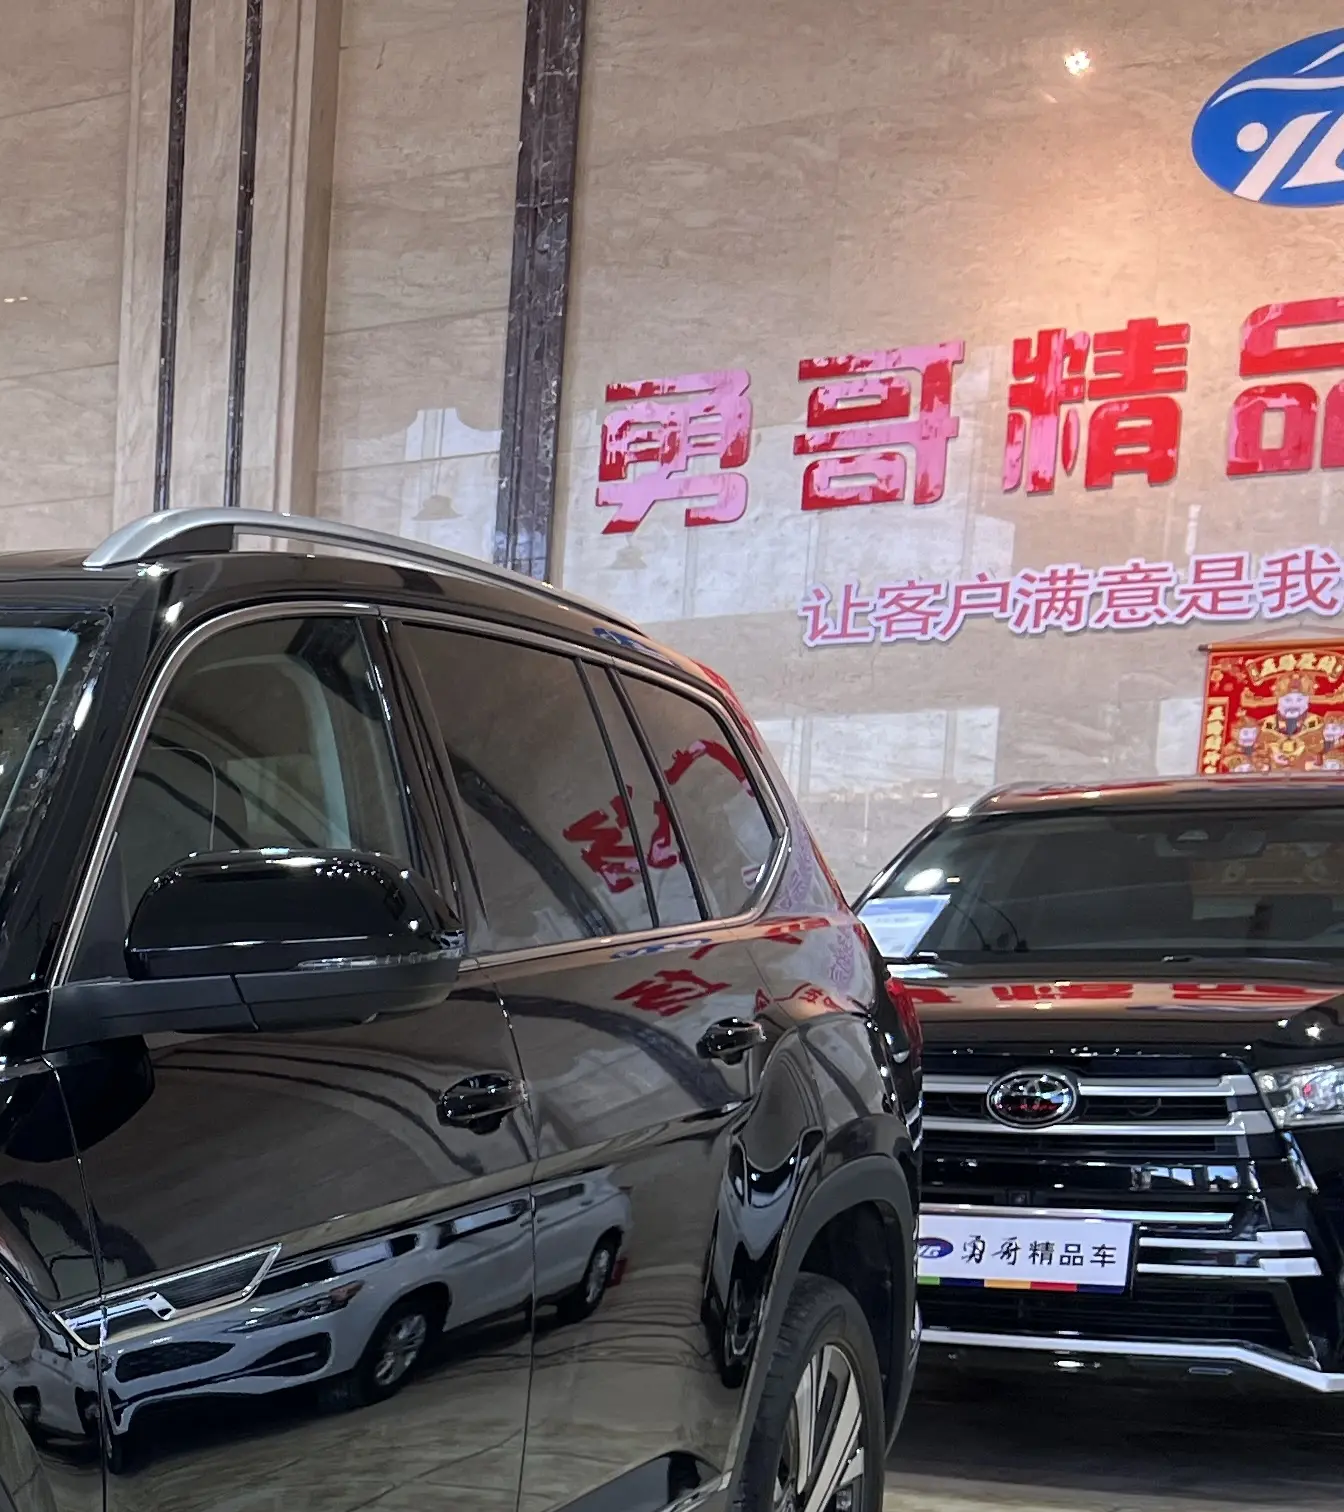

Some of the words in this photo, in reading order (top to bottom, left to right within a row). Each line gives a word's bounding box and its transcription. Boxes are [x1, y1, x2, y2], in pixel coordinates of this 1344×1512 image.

[802, 549, 1342, 643] 让客户满意是我
[961, 1234, 1117, 1268] 勇哥精品车
